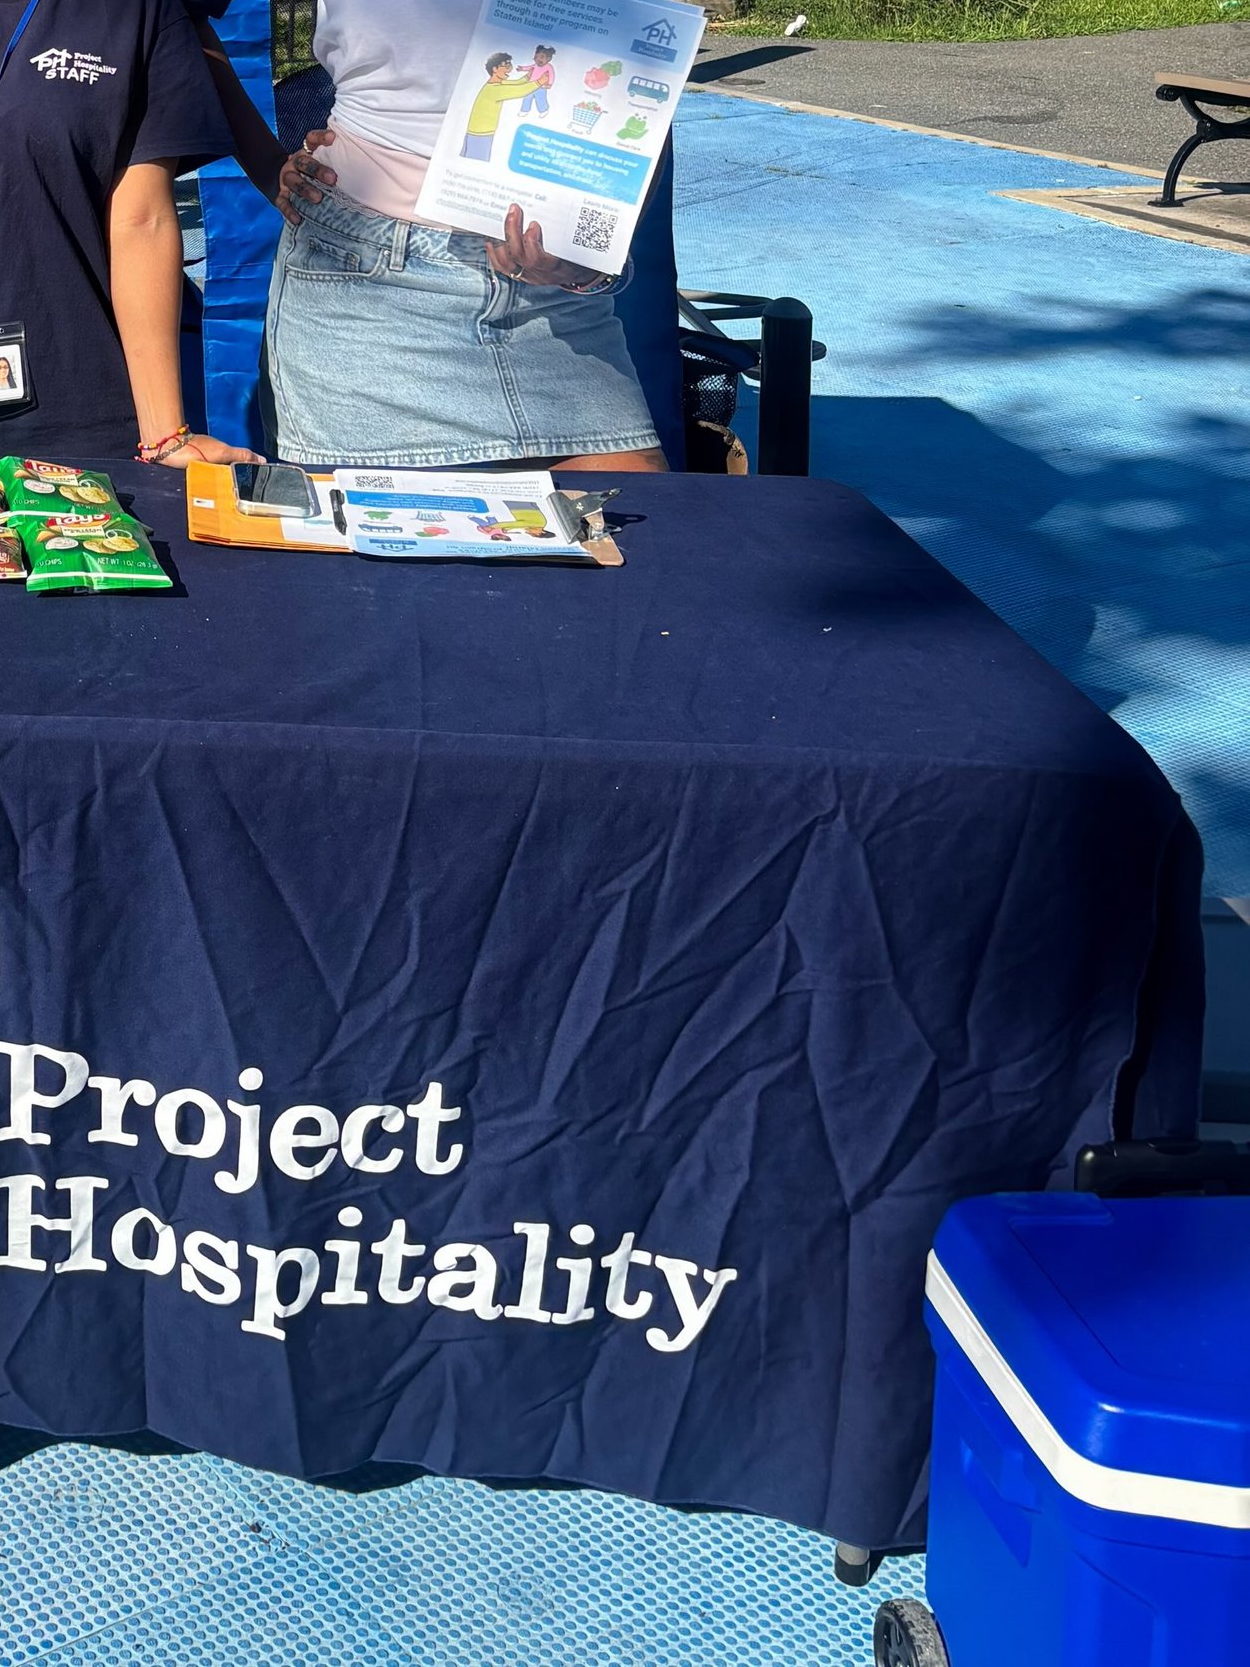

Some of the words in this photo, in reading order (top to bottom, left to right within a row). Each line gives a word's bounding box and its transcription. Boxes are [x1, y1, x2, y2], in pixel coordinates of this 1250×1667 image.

[533, 0, 547, 9] for
[549, 4, 566, 15] free
[586, 4, 606, 16] may
[607, 8, 619, 18] be
[493, 9, 523, 24] Staten
[523, 18, 554, 31] Island!
[497, 0, 531, 17] through
[532, 11, 539, 19] a
[540, 13, 557, 24] new
[558, 18, 597, 35] program
[597, 27, 610, 36] on
[645, 21, 676, 46] PH
[37, 49, 67, 71] PH
[74, 53, 102, 62] Project
[74, 60, 117, 75] Hospitality
[45, 67, 99, 85] STAFF
[97, 557, 109, 565] NET
